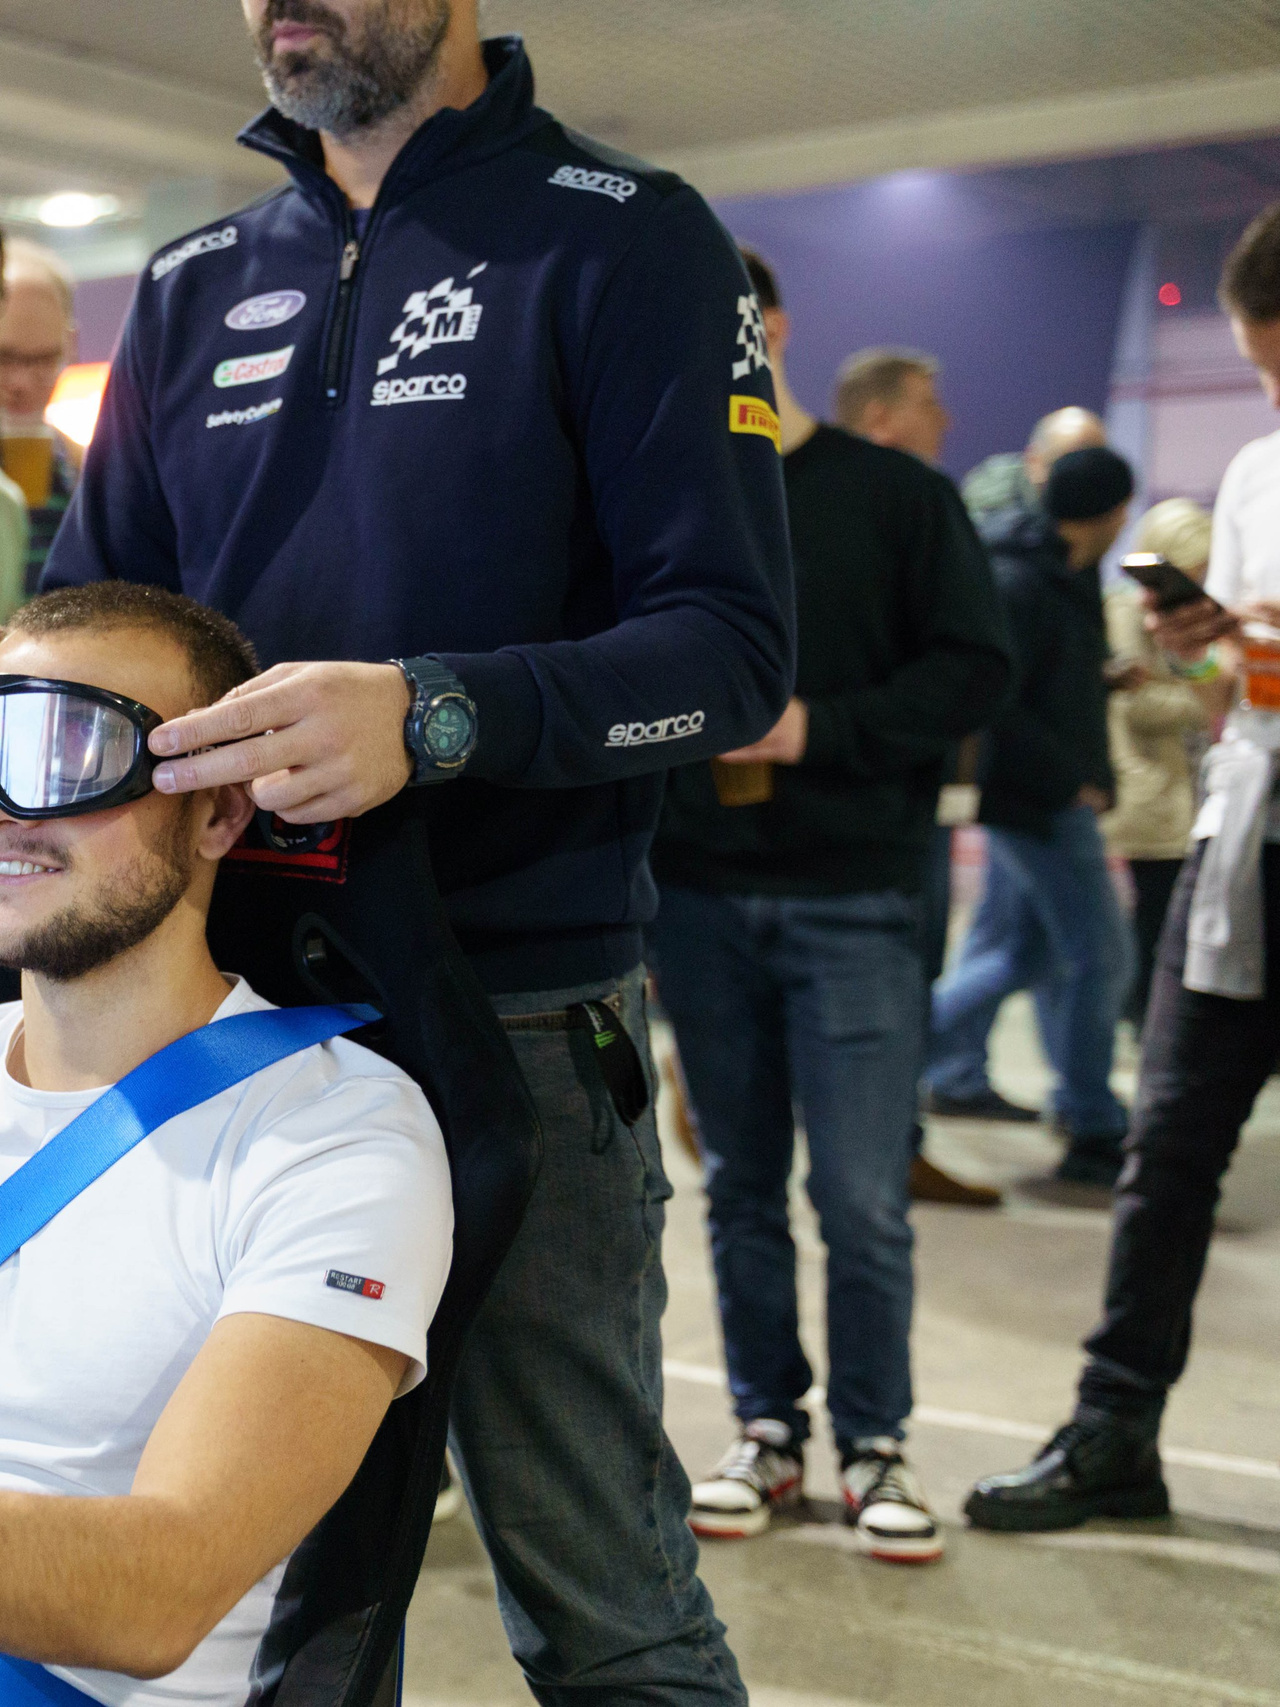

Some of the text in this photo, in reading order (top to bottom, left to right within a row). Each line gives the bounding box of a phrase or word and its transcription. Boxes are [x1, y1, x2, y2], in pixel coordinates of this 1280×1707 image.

[548, 165, 637, 203] sparco
[151, 226, 238, 281] sparco
[371, 373, 467, 406] sparco
[605, 711, 705, 747] sparco
